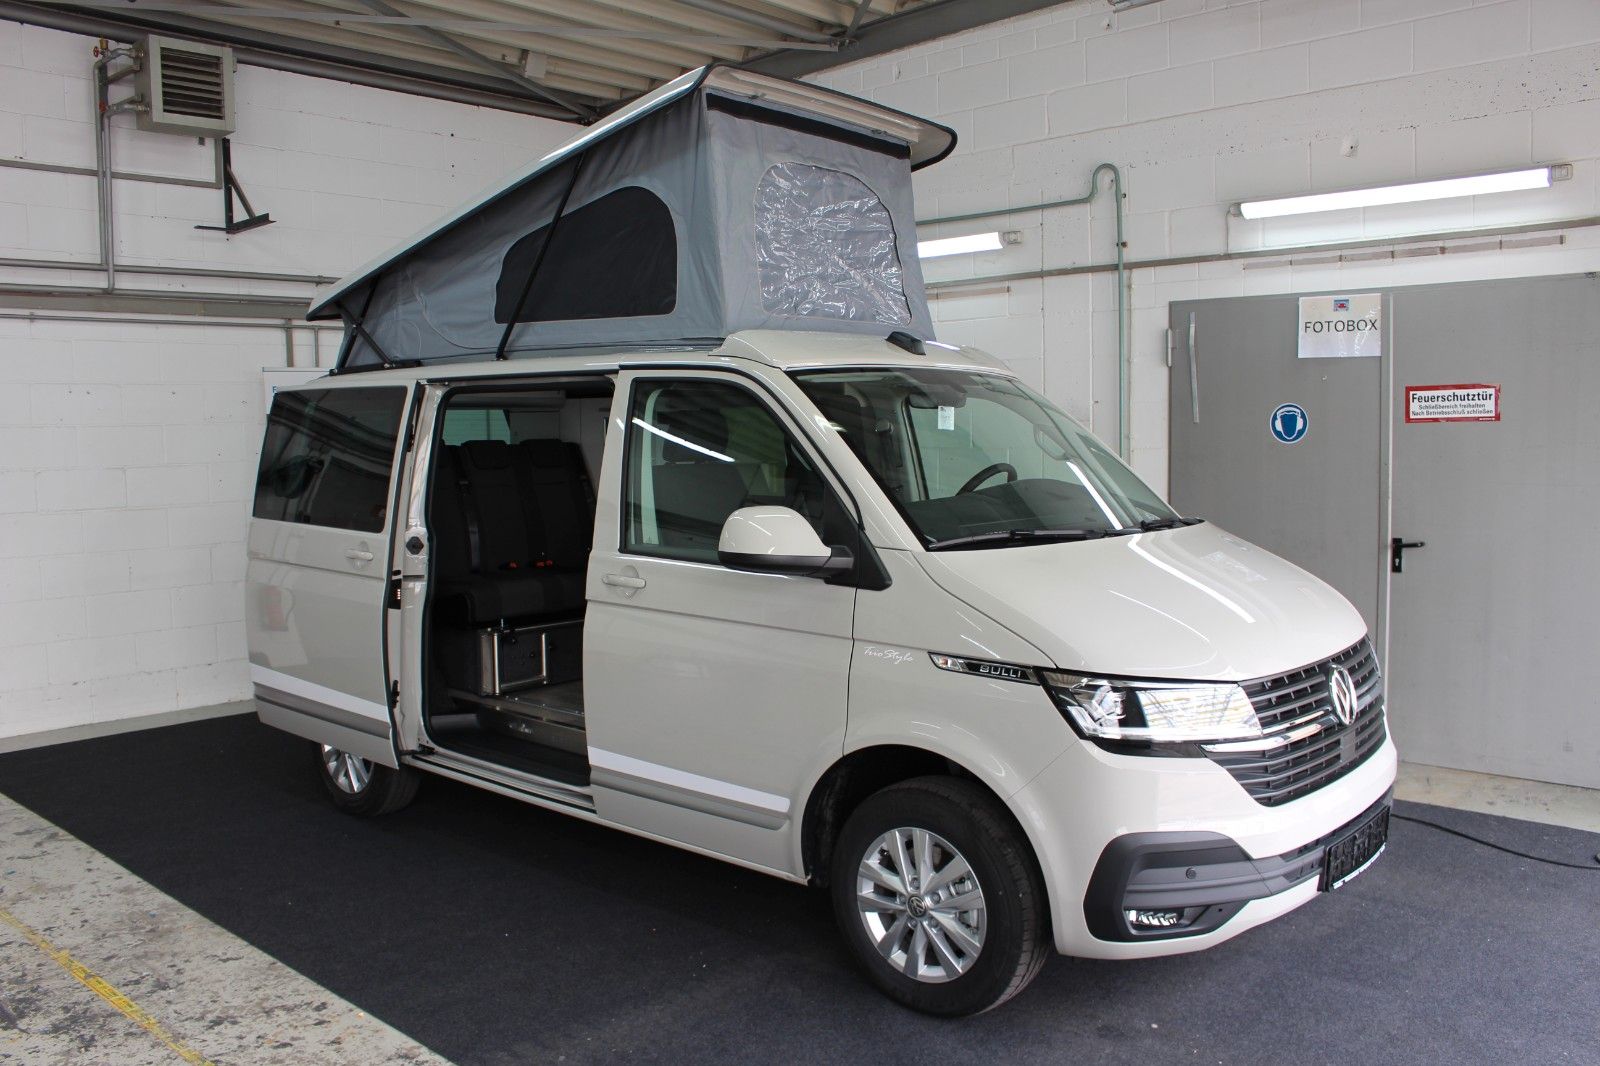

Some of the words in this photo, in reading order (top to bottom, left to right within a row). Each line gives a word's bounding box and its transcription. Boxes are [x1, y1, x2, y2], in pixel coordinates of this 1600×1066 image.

[1304, 319, 1378, 333] FOTOBOX
[1411, 391, 1493, 403] Feuerschutztür
[980, 664, 1021, 677] BULLI
